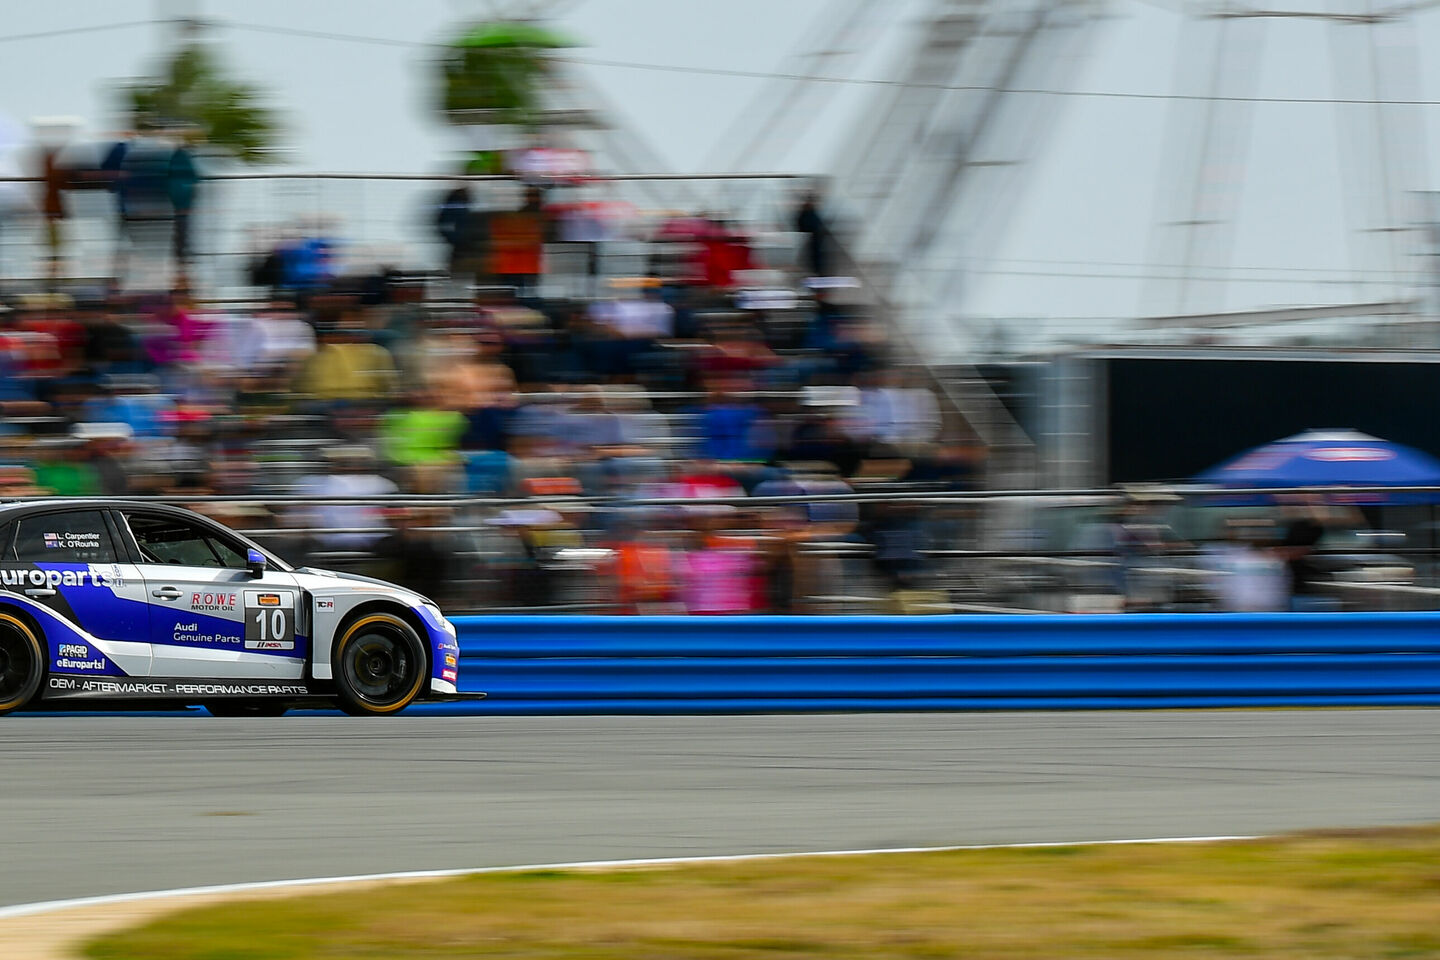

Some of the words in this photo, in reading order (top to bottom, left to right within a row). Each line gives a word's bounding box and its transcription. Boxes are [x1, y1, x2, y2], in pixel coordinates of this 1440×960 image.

[64, 532, 100, 541] Carpentier
[67, 540, 100, 548] O'Rourke
[191, 592, 237, 606] ROWE
[174, 622, 198, 632] Audi
[255, 609, 286, 640] 10
[173, 632, 213, 642] Genuine
[214, 633, 241, 644] Parts
[66, 644, 88, 654] PAGID
[49, 678, 75, 689] OEM
[82, 680, 168, 693] AFTERMARKET
[175, 684, 267, 695] PERFORMANCE
[267, 686, 308, 695] PARTS
